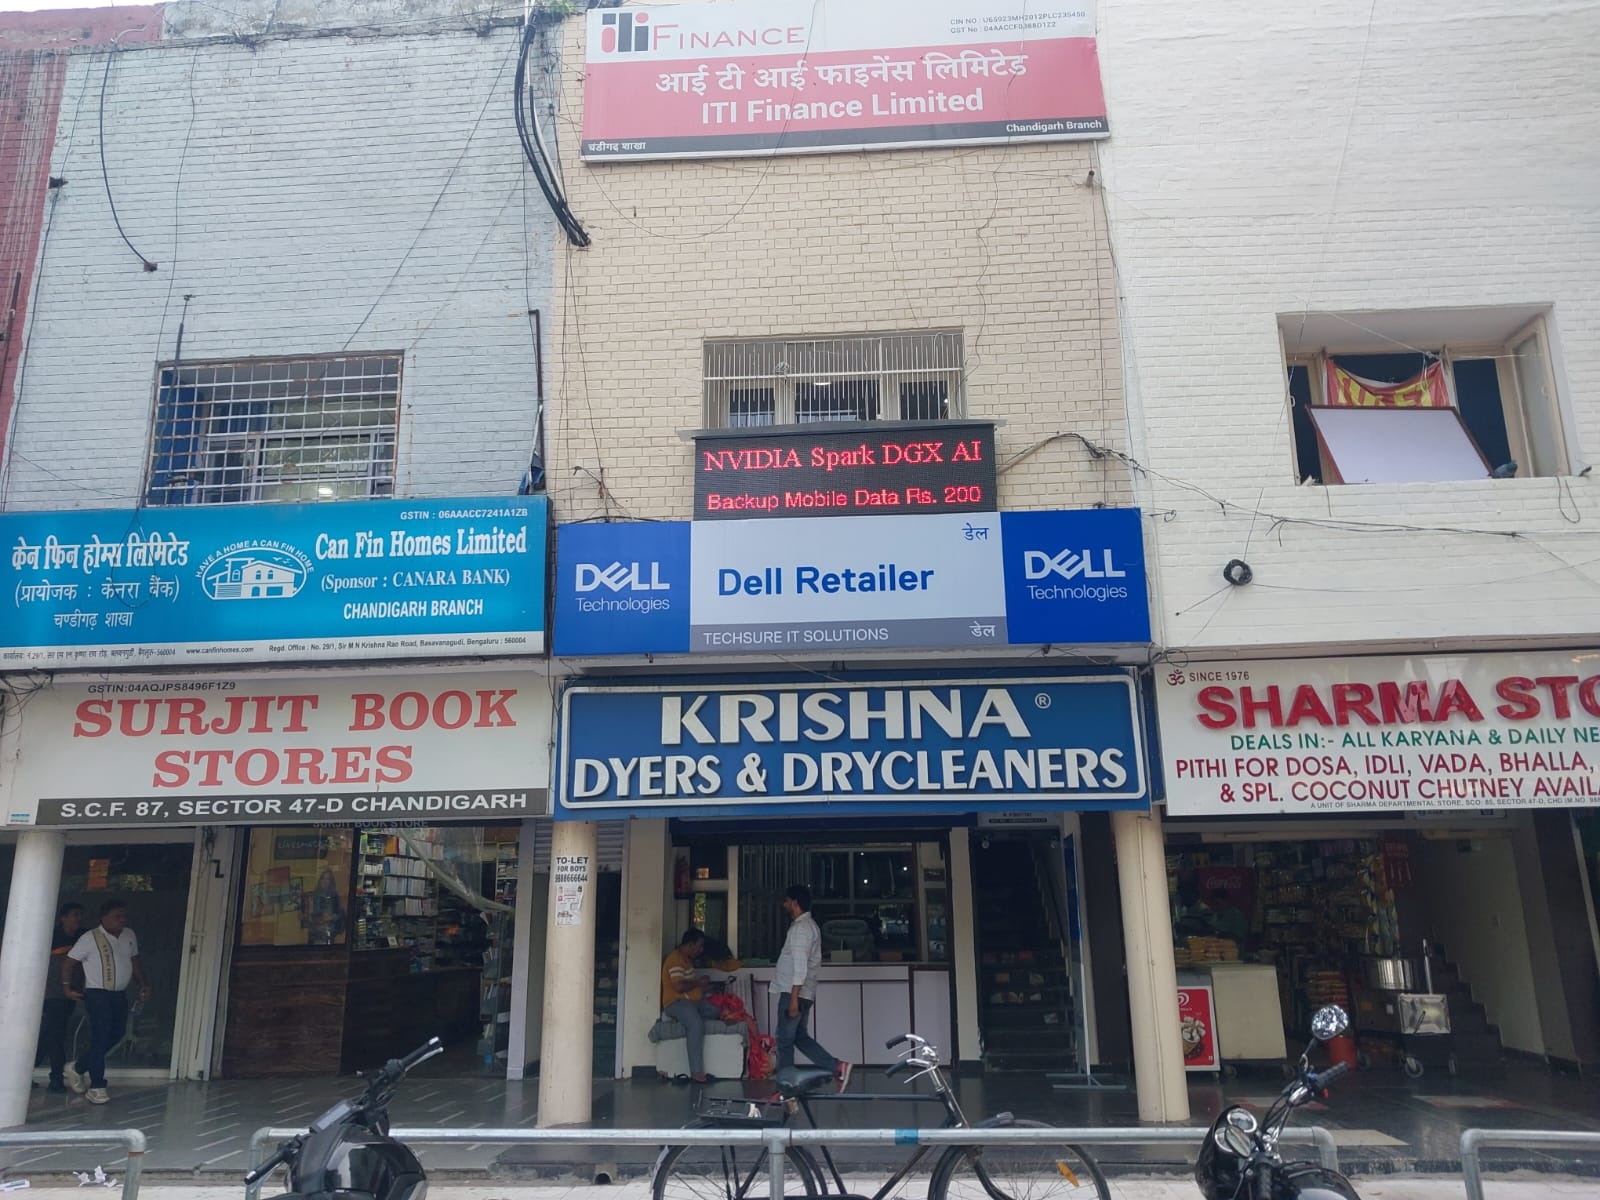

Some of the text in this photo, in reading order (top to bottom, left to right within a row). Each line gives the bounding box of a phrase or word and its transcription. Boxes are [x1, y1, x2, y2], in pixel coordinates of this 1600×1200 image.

[653, 23, 804, 50] FINANCE
[655, 48, 1029, 96] आई टी आई फाइनेंस लिमिटेड
[702, 88, 984, 124] ITI Finance Limited
[1006, 119, 1102, 133] Chandigarh Branch
[703, 440, 982, 471] NVIDIA Spark DGX AI
[707, 486, 982, 512] Backup Mobile Data Rs. 200
[400, 511, 430, 520] GSTIN
[315, 526, 528, 560] Can Fin Homes Limited
[961, 522, 990, 541] डेल
[43, 534, 82, 570] फिन
[83, 534, 125, 575] होम्स
[126, 531, 190, 568] लिमिटेड
[195, 554, 215, 578] HAVE
[223, 540, 250, 554] HOME
[251, 539, 259, 547] A
[260, 539, 280, 548] CAN
[280, 542, 296, 554] FIN
[294, 549, 315, 574] HOME
[1023, 548, 1126, 580] DELL
[101, 577, 141, 601] केनरा
[149, 574, 180, 604] बैंक)
[320, 574, 378, 593] (Sponsor
[392, 571, 457, 588] CANARA
[461, 568, 510, 587] BANK)
[575, 561, 671, 592] DELL
[718, 563, 935, 597] Dell Retailer
[575, 597, 671, 614] Technologies
[1026, 584, 1128, 602] Technologies
[53, 608, 134, 631] चण्डीगढ़ शाखा
[343, 599, 484, 620] CHANDIGARH BRANCH
[703, 628, 889, 645] TECHSURE IT SOLUTIONS
[968, 620, 996, 638] डेल
[185, 646, 254, 654] www.canfinhomes.com
[287, 644, 306, 652] Office
[338, 642, 348, 650] Sir
[361, 640, 385, 649] Krishna
[386, 640, 399, 648] Rao
[467, 637, 499, 646] Bengaluru
[1188, 671, 1250, 682] SINCE 1976
[72, 689, 518, 738] SURJIT BOOK
[660, 687, 1031, 746] KRISHNA
[1196, 679, 1485, 729] SHARMA
[1231, 733, 1293, 751] DEALS
[1341, 731, 1376, 748] ALL
[1381, 729, 1482, 747] KARYANA
[1488, 728, 1502, 745] &
[1508, 727, 1567, 745] DAILY
[152, 744, 414, 788] STORES
[573, 746, 1127, 799] DYERS & DRYCLEANERS
[1176, 751, 1594, 778] PITHI FOR DOSA, IDLI, VADA, BHALLA,
[1220, 776, 1600, 803] & SPL. COCONUT CHUTNEY AVAIL
[60, 793, 527, 819] S.C.F. 87, SECTOR 47-D CHANDIGARH
[1379, 800, 1434, 808] DEPARTMENTAL
[354, 820, 388, 828] BOOK
[390, 819, 428, 828] STORE
[556, 856, 589, 865] TO-LET
